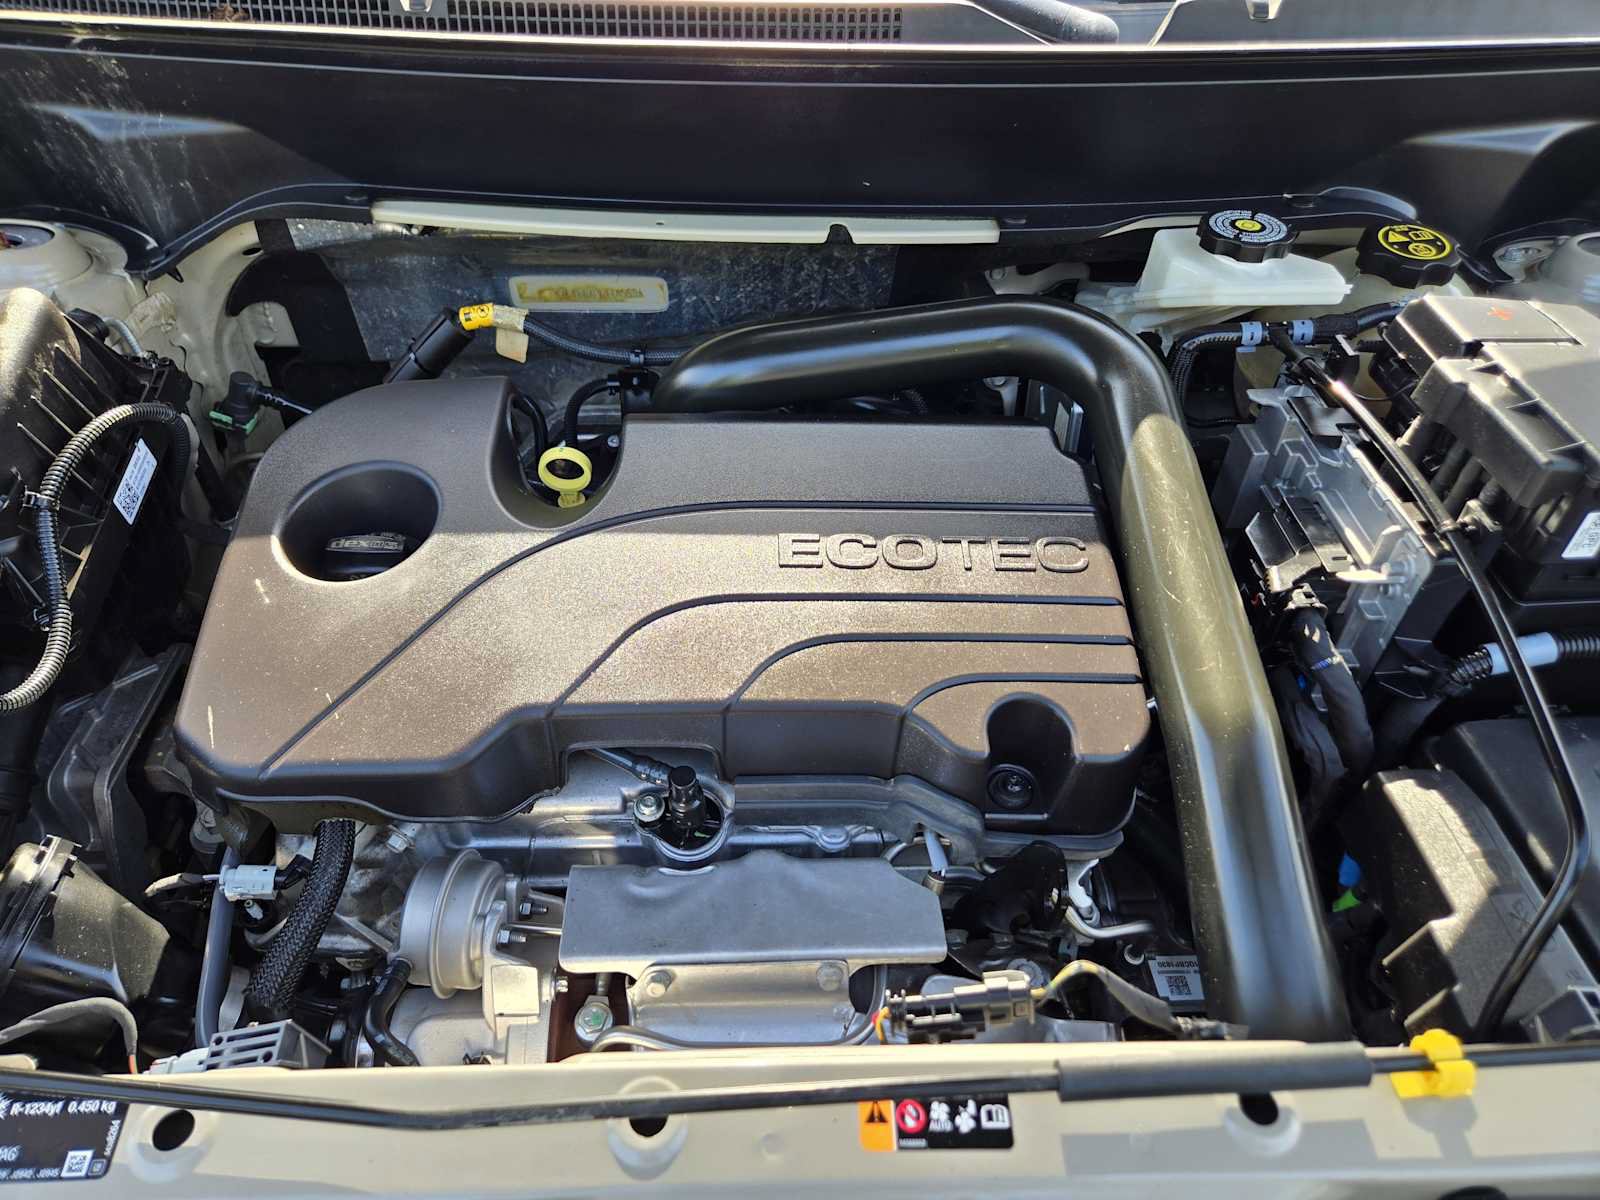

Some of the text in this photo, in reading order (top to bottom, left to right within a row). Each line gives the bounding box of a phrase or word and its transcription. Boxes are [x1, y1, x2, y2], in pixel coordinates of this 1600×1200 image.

[778, 533, 1089, 573] ECOTEC
[68, 1100, 99, 1114] 0.450
[100, 1100, 117, 1115] kg
[929, 1120, 953, 1132] AUTO
